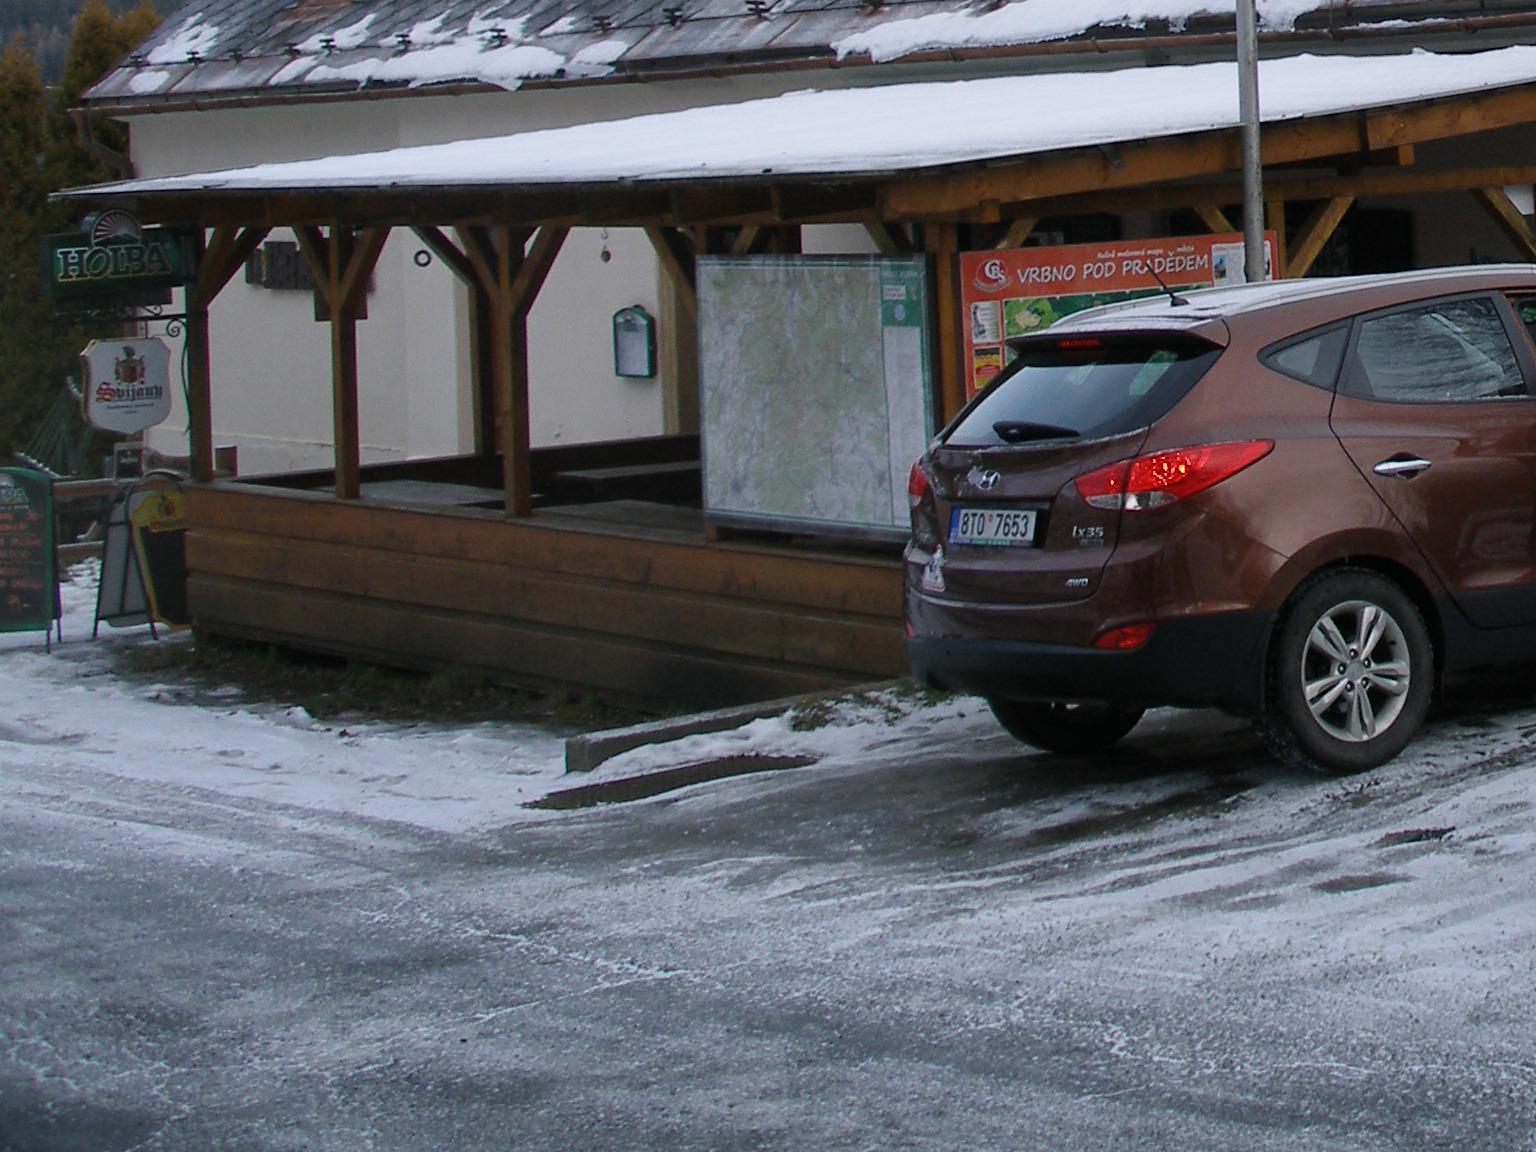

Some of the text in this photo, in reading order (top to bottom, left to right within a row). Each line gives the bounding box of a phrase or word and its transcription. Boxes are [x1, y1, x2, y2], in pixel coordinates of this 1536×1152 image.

[57, 243, 172, 282] HOLBA
[1017, 264, 1076, 284] VRBNO
[1083, 262, 1116, 279] POD
[994, 513, 1029, 538] 7653
